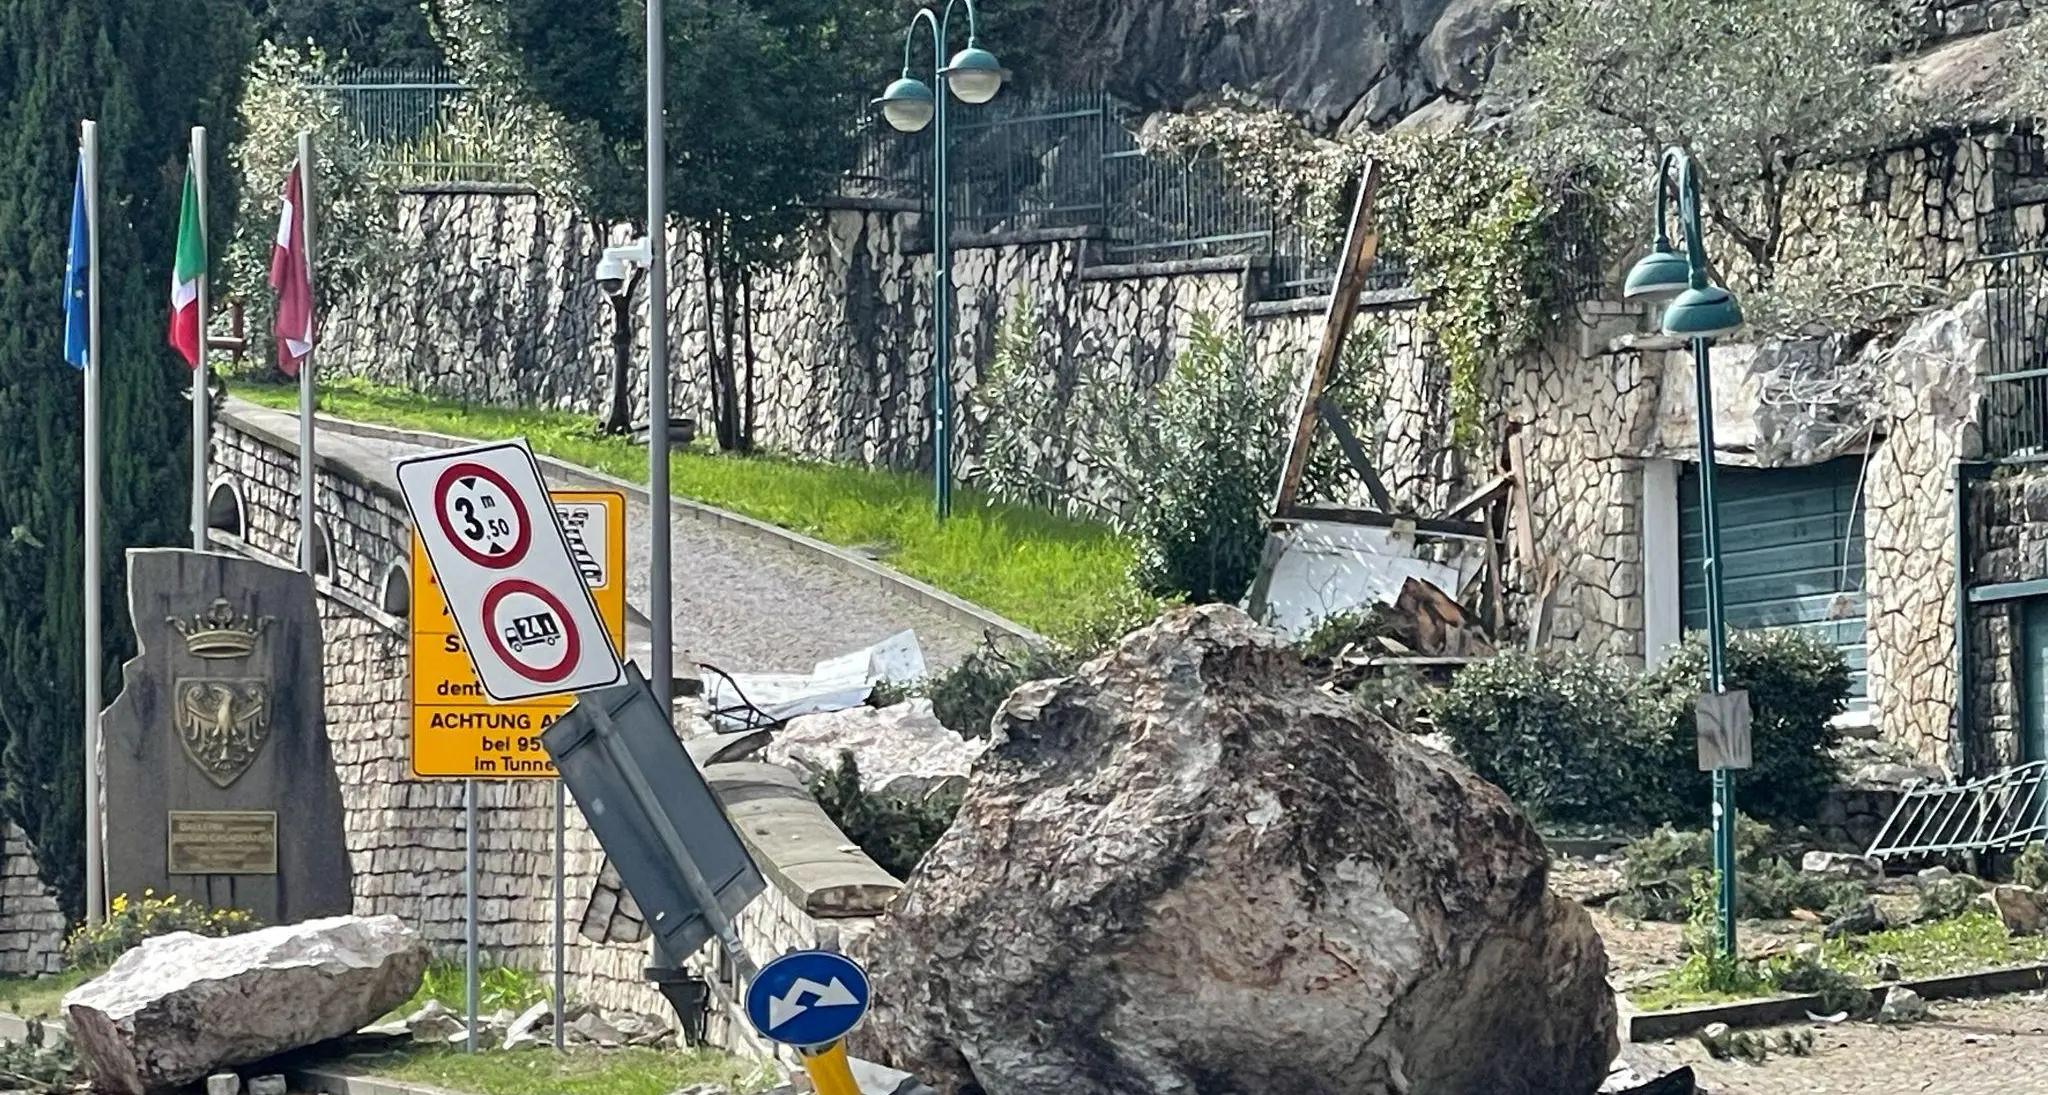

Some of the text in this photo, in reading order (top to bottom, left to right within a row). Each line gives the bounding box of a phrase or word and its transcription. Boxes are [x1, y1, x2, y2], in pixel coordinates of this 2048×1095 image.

[437, 679, 485, 696] dent
[430, 712, 531, 730] ACHTUNG
[500, 756, 555, 772] Tunne
